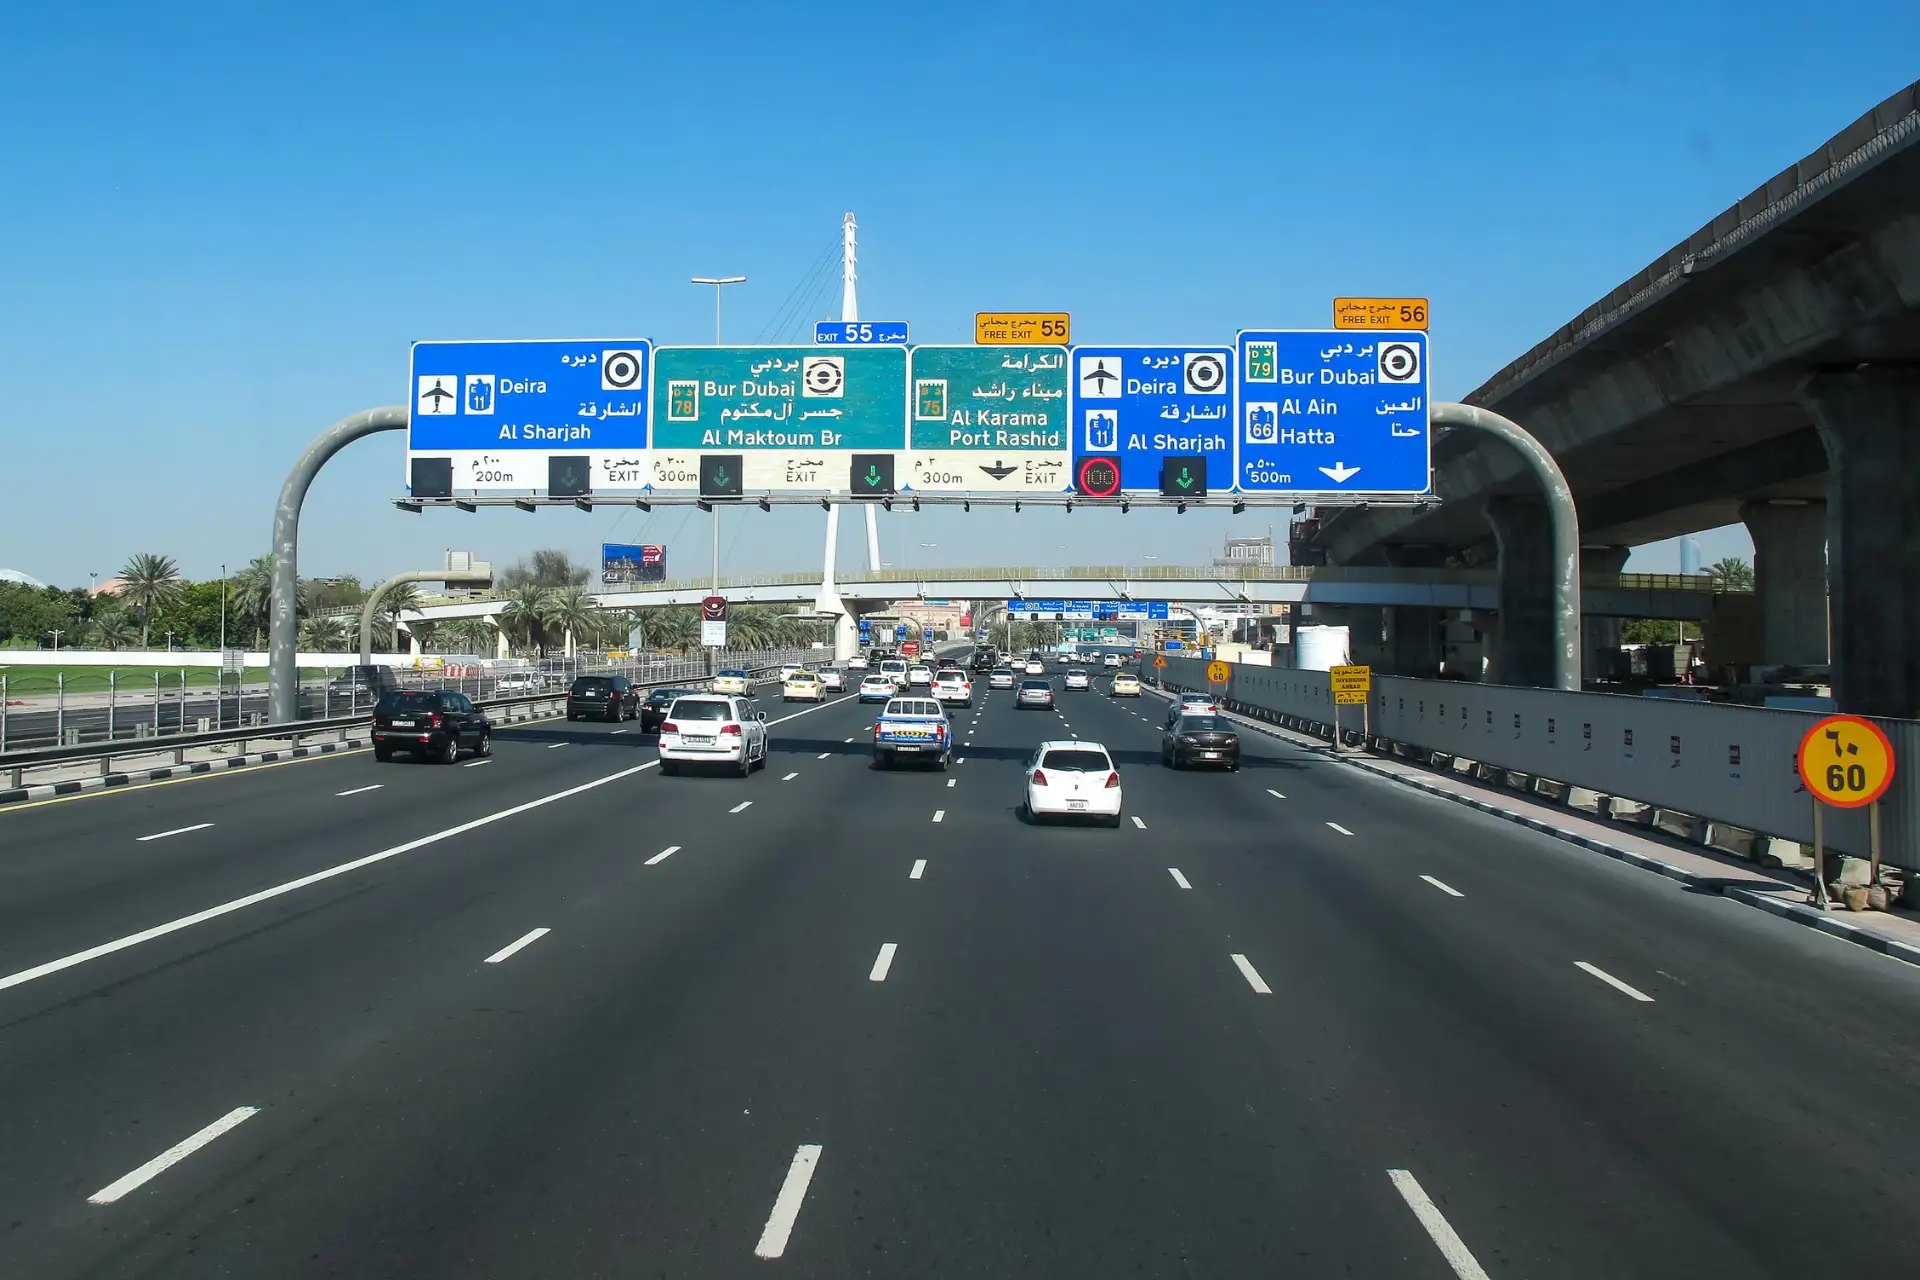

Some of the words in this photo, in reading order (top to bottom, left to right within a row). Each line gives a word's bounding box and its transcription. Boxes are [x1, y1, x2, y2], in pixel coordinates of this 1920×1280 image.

[1343, 316, 1365, 324] FREE
[1370, 316, 1390, 324] EXIT
[1400, 306, 1424, 322] 56
[818, 334, 838, 342] EXIT
[846, 324, 872, 342] 55
[985, 330, 1006, 338] FREE
[1012, 330, 1032, 338] EXIT
[1042, 320, 1066, 336] 55
[878, 332, 906, 342] مخرج
[562, 352, 597, 367] ديره
[1143, 356, 1179, 369] ديره
[1251, 351, 1260, 359] D
[1002, 354, 1063, 372] الكرامة
[1252, 362, 1270, 376] 79
[1282, 369, 1314, 384] Bur
[1320, 369, 1374, 384] Dubai
[501, 378, 546, 393] Deira
[705, 381, 736, 396] Bur
[743, 381, 794, 396] Dubai
[972, 382, 1014, 400] راشد
[1022, 382, 1062, 400] ميناء
[1128, 379, 1176, 394] Deira
[474, 396, 486, 410] 11
[674, 400, 692, 414] 78
[923, 400, 940, 416] 75
[1280, 399, 1302, 416] Al
[1308, 399, 1336, 414] Ain
[1376, 397, 1420, 414] العين
[578, 402, 641, 420] الشارقة
[799, 409, 842, 420] جسر
[952, 410, 970, 426] Al
[977, 410, 1048, 426] Karama
[1160, 404, 1226, 423] الشارقة
[499, 425, 517, 440] Al
[523, 424, 590, 441] Sharjah
[1252, 424, 1272, 437] 66
[1282, 429, 1334, 444] Hatta
[1392, 423, 1420, 436] حتا
[702, 430, 721, 445] Al
[727, 430, 815, 446] Maktoum
[820, 430, 842, 446] Br
[950, 430, 990, 446] Port
[996, 430, 1059, 446] Rashid
[1097, 431, 1107, 444] 11
[1128, 434, 1147, 449] Al
[1154, 434, 1225, 452] Sharjah
[603, 456, 640, 469] مخرج
[1026, 458, 1062, 471] مخرج
[476, 471, 512, 481] 200m
[610, 471, 639, 481] EXIT
[659, 470, 697, 481] 300m
[787, 472, 816, 482] EXIT
[923, 472, 962, 483] 300m
[1026, 473, 1056, 483] EXIT
[1086, 470, 1114, 484] 100
[1251, 472, 1292, 483] 500m
[1826, 728, 1858, 758] ٦٠
[1826, 764, 1865, 791] 60
